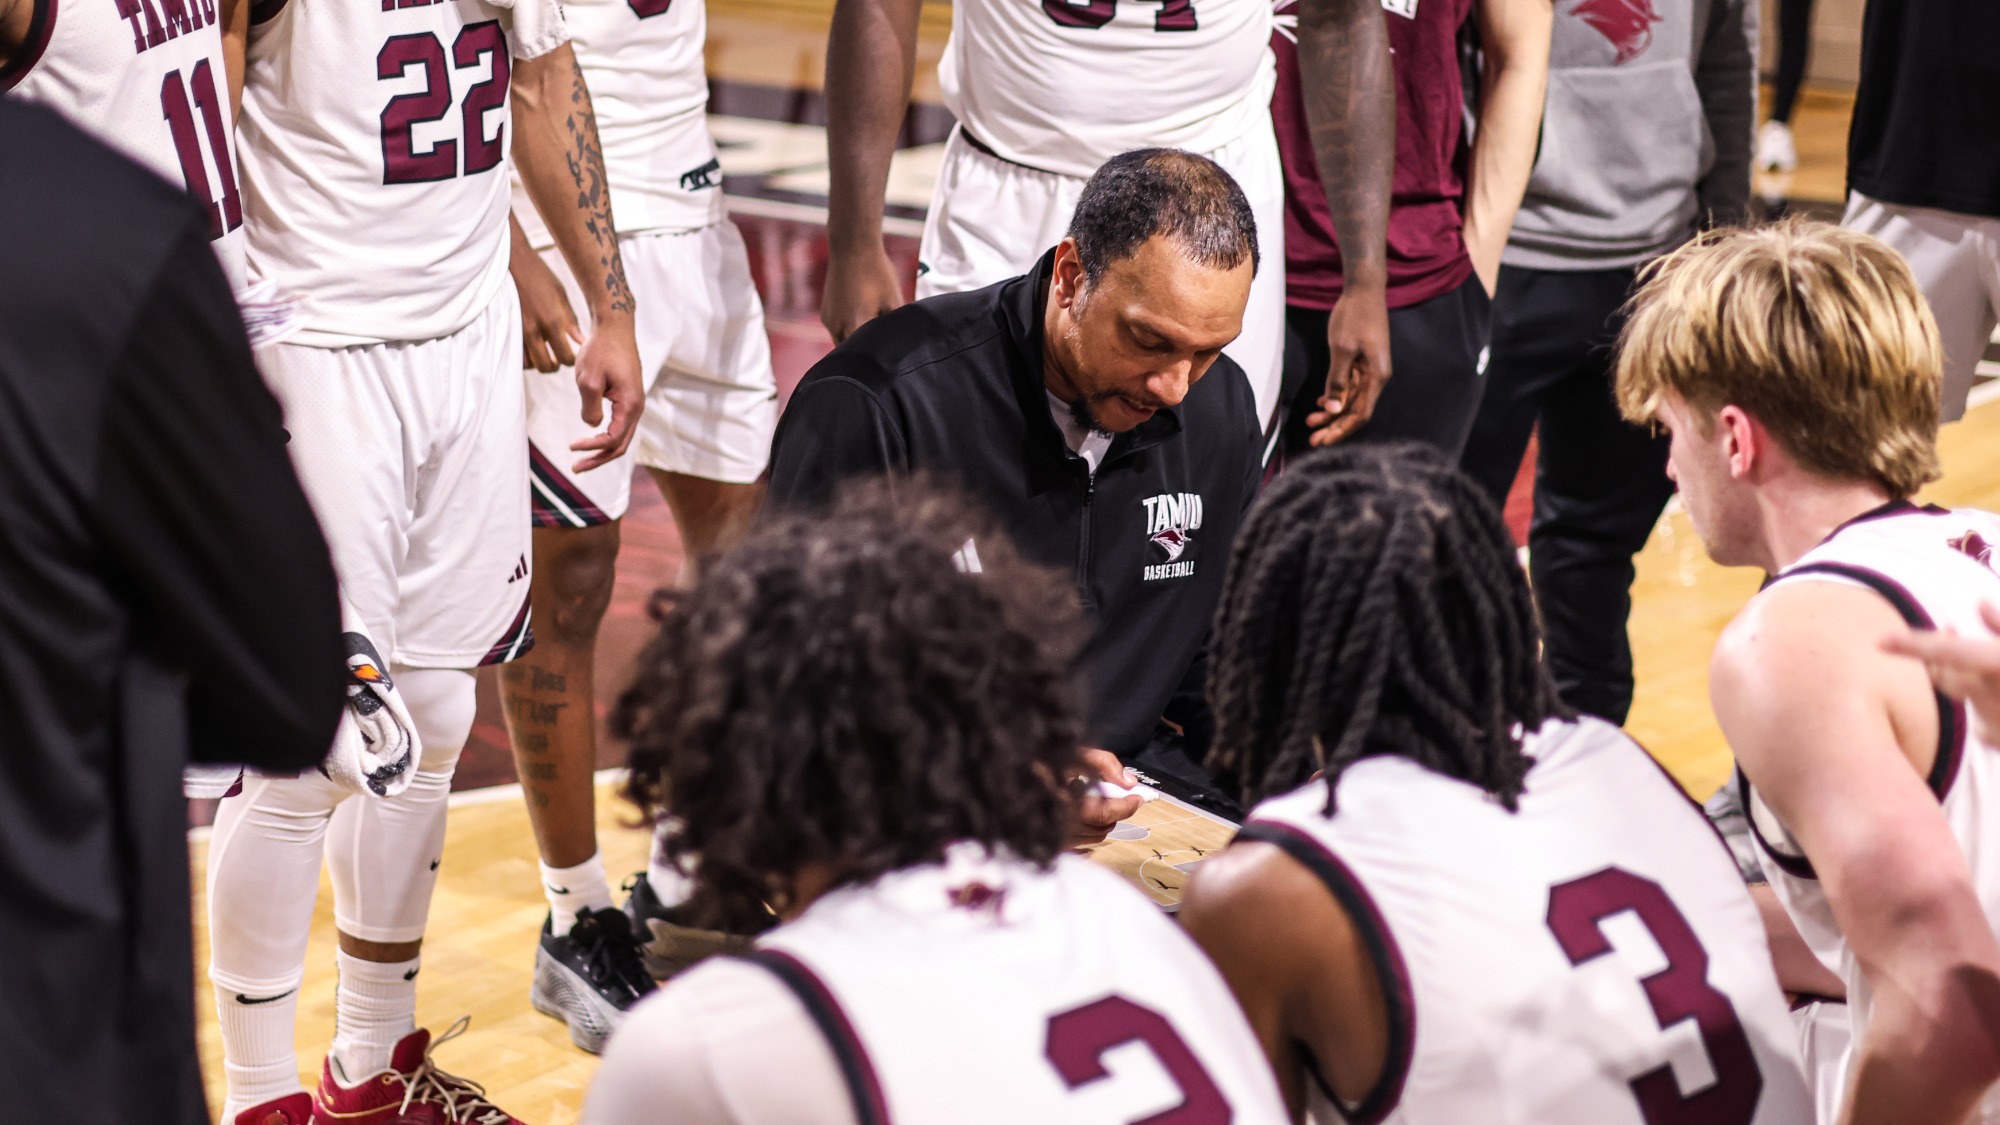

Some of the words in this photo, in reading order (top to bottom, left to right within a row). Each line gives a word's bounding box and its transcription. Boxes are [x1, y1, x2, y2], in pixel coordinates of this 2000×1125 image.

[160, 57, 243, 242] 11
[377, 19, 511, 185] 22
[1142, 492, 1203, 535] TAMIU
[1143, 560, 1195, 581] BASKETBALL
[1546, 865, 1765, 1125] 3
